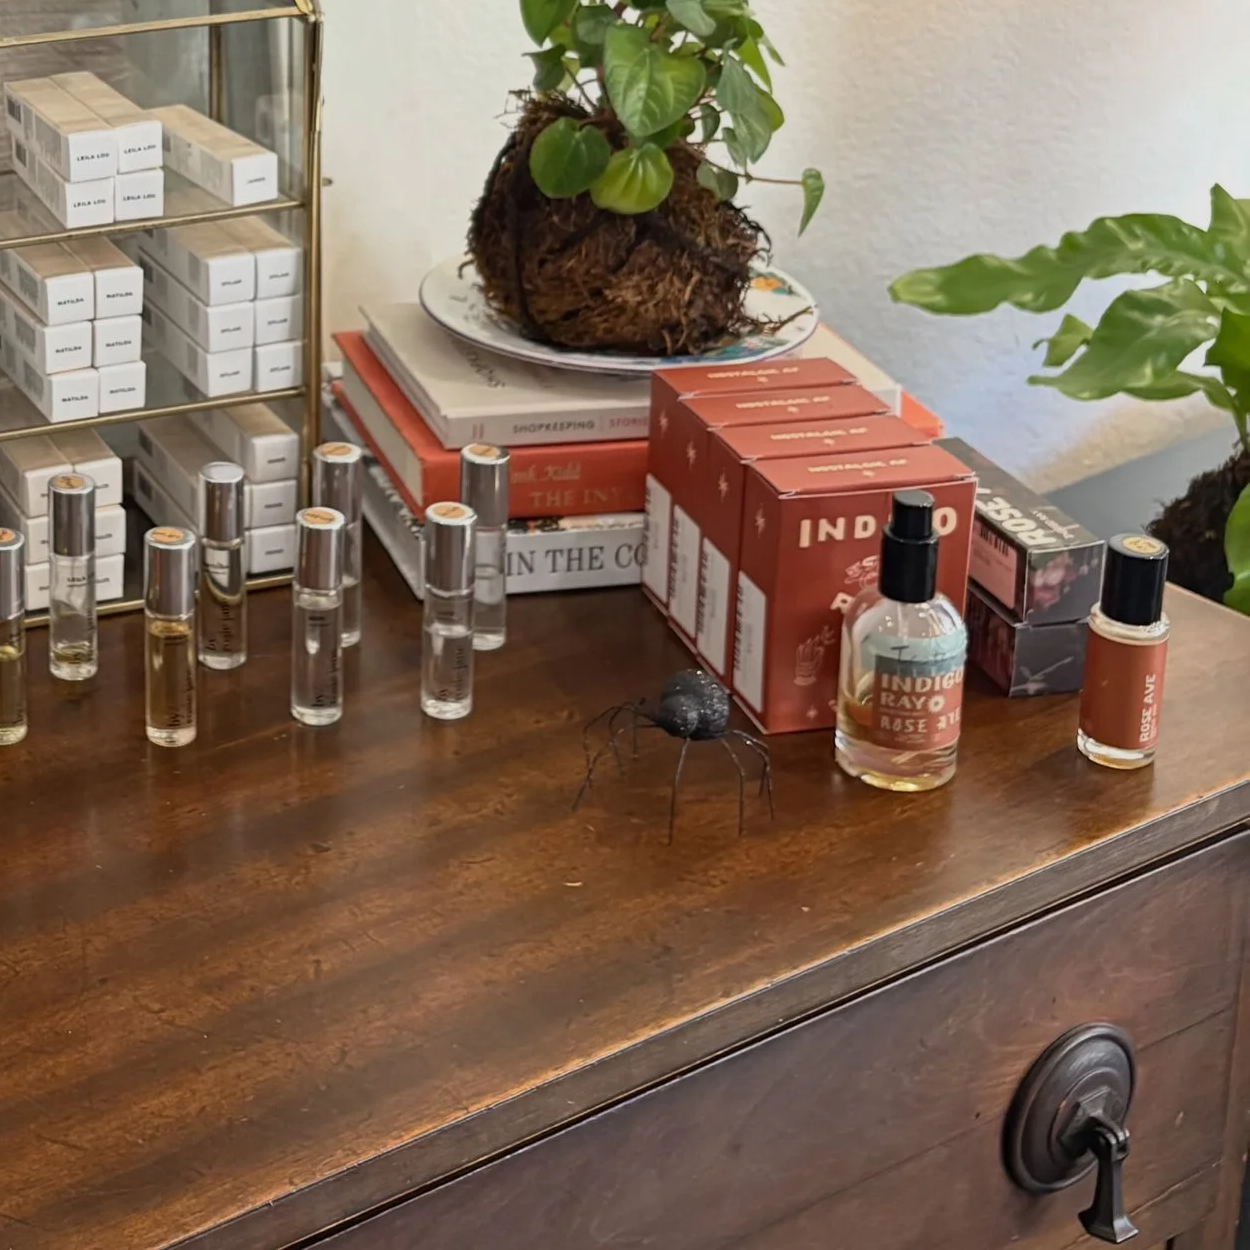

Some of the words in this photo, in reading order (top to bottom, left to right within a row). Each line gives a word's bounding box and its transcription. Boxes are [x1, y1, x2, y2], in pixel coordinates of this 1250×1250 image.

[77, 152, 94, 162] LEILA
[97, 151, 110, 159] LOU
[58, 296, 84, 306] MATILDA
[107, 291, 133, 300] MATILDA
[513, 419, 595, 435] SHOPKEEPING
[528, 489, 576, 507] THE
[976, 497, 1056, 546] ROSE
[506, 551, 535, 577] IN
[545, 548, 604, 573] THE
[1143, 673, 1156, 704] AVE
[880, 695, 925, 709] RAY
[881, 718, 928, 732] ROSE
[1139, 706, 1152, 742] ROSE
